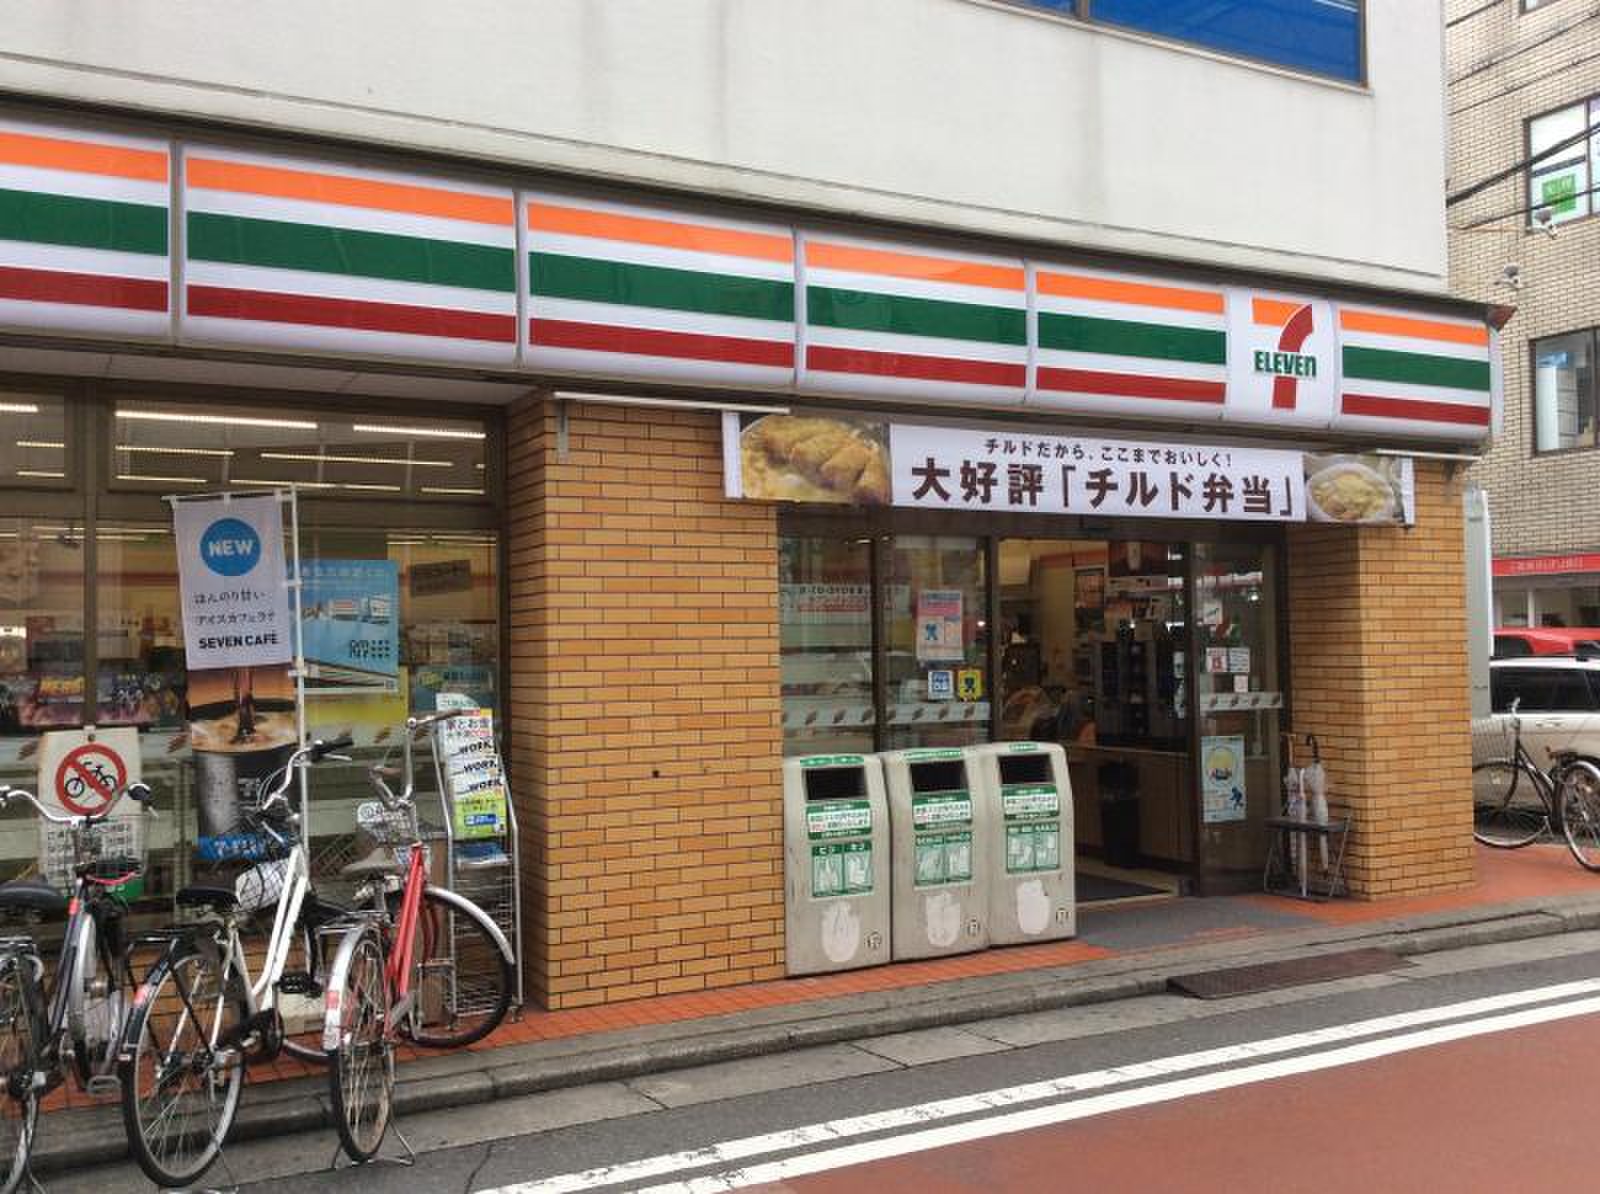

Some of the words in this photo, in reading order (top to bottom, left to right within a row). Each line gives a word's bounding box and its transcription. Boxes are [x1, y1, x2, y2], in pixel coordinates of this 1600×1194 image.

[911, 457, 1293, 516] 大好評「チルド弁当」
[207, 539, 253, 557] NEW
[199, 635, 243, 649] SEVEN
